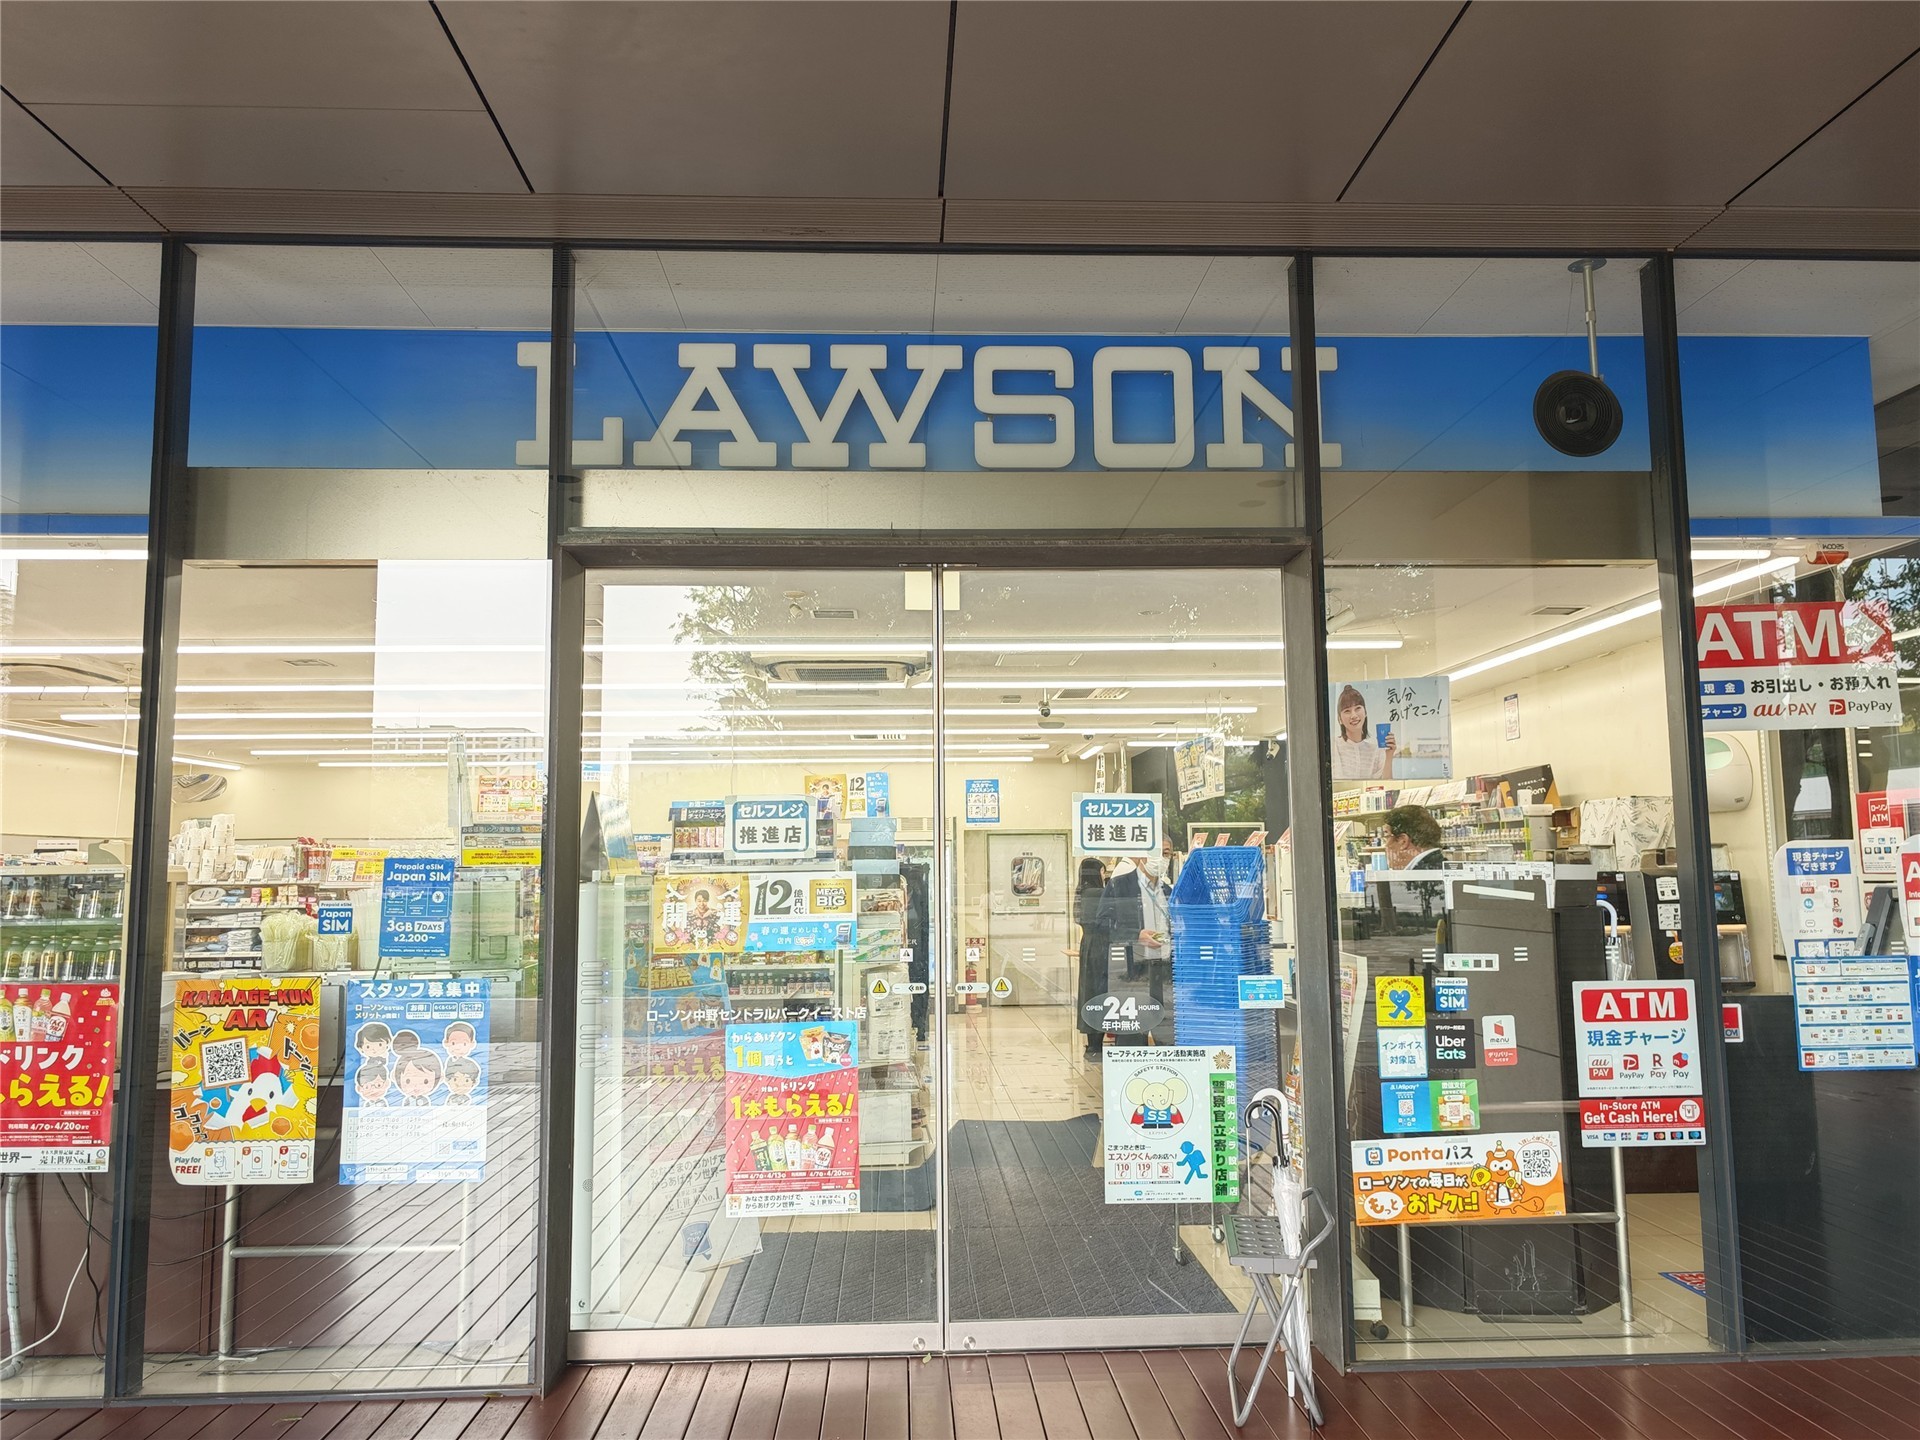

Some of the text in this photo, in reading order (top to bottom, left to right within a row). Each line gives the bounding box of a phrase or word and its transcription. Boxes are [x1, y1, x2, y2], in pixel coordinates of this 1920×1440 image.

[515, 342, 1342, 467] LAWSON
[1698, 610, 1840, 661] ATM
[1704, 676, 1891, 693] 現金 お引出し・お預入れ
[1387, 687, 1416, 704] 気分
[1390, 699, 1442, 721] あげてこっ!
[1702, 706, 1742, 716] チャージ
[1754, 700, 1892, 717] au PAY PayPay
[850, 777, 865, 791] 12
[738, 803, 804, 818] セルフレジ
[1085, 803, 1149, 816] セルフレジ
[740, 825, 802, 844] 推進店
[1087, 824, 1148, 842] 推進店
[1792, 851, 1843, 861] 現金チャージ
[394, 863, 424, 871] Prepaid
[1801, 862, 1837, 871] できます
[387, 871, 450, 882] Japan SIM
[754, 879, 793, 915] 12
[816, 888, 846, 896] MEGA
[793, 889, 803, 914] 億円くじ
[816, 895, 846, 907] BIG
[1833, 898, 1839, 907] R
[321, 910, 351, 919] Japan
[662, 902, 742, 928] 開 運
[322, 920, 349, 931] SIM
[387, 920, 442, 932] 3GB 7DAYS
[761, 926, 822, 936] 春の運だめしは、
[777, 937, 792, 945] 店内
[360, 982, 480, 998] スタッフ募集中
[1438, 987, 1466, 996] Japan
[182, 989, 313, 1007] KARAAGE-KUN
[1440, 997, 1465, 1008] SIM
[1103, 996, 1138, 1020] 24
[1596, 992, 1676, 1019] ATM
[647, 1007, 867, 1021] ローソン中野セントラルパークイースト店
[1102, 1020, 1140, 1031] 年中無休
[174, 1026, 213, 1049] バーン
[731, 1031, 796, 1044] からあげクン
[1436, 1036, 1466, 1047] Uber
[1587, 1028, 1686, 1046] 現金チャージ
[1382, 1041, 1423, 1050] インボイス
[733, 1045, 794, 1068] 1個買うと
[1106, 1050, 1206, 1058] セーフティステーション活動実施店
[1390, 1056, 1416, 1065] 対象店
[1436, 1048, 1466, 1060] Eats
[1592, 1058, 1609, 1066] au
[1134, 1066, 1178, 1077] SAFETY STATION
[1593, 1069, 1609, 1077] PAY
[1650, 1071, 1667, 1079] Pay
[1673, 1069, 1689, 1079] Pay
[0, 1074, 110, 1107] らえる!
[730, 1093, 854, 1119] 1本もらえる!
[1599, 1101, 1660, 1111] In-Store ATM
[1584, 1110, 1678, 1124] Get Cash Here!
[1212, 1081, 1228, 1196] 警察官立寄り店舗
[1226, 1080, 1239, 1196] 防犯カメラ設置店
[0, 1151, 32, 1164] 世界一
[174, 1156, 201, 1165] Play for
[1108, 1152, 1177, 1161] エスゾウくんのお店へ!
[1388, 1146, 1474, 1162] Pontaパス
[175, 1166, 202, 1175] FREE!
[1117, 1163, 1129, 1171] 110
[1359, 1172, 1469, 1190] ローソンでの毎日が、
[745, 1194, 803, 1202] みなさまのおかげで、
[1368, 1191, 1479, 1214] もっと おトクに!
[745, 1201, 801, 1209] からあげクン世界一
